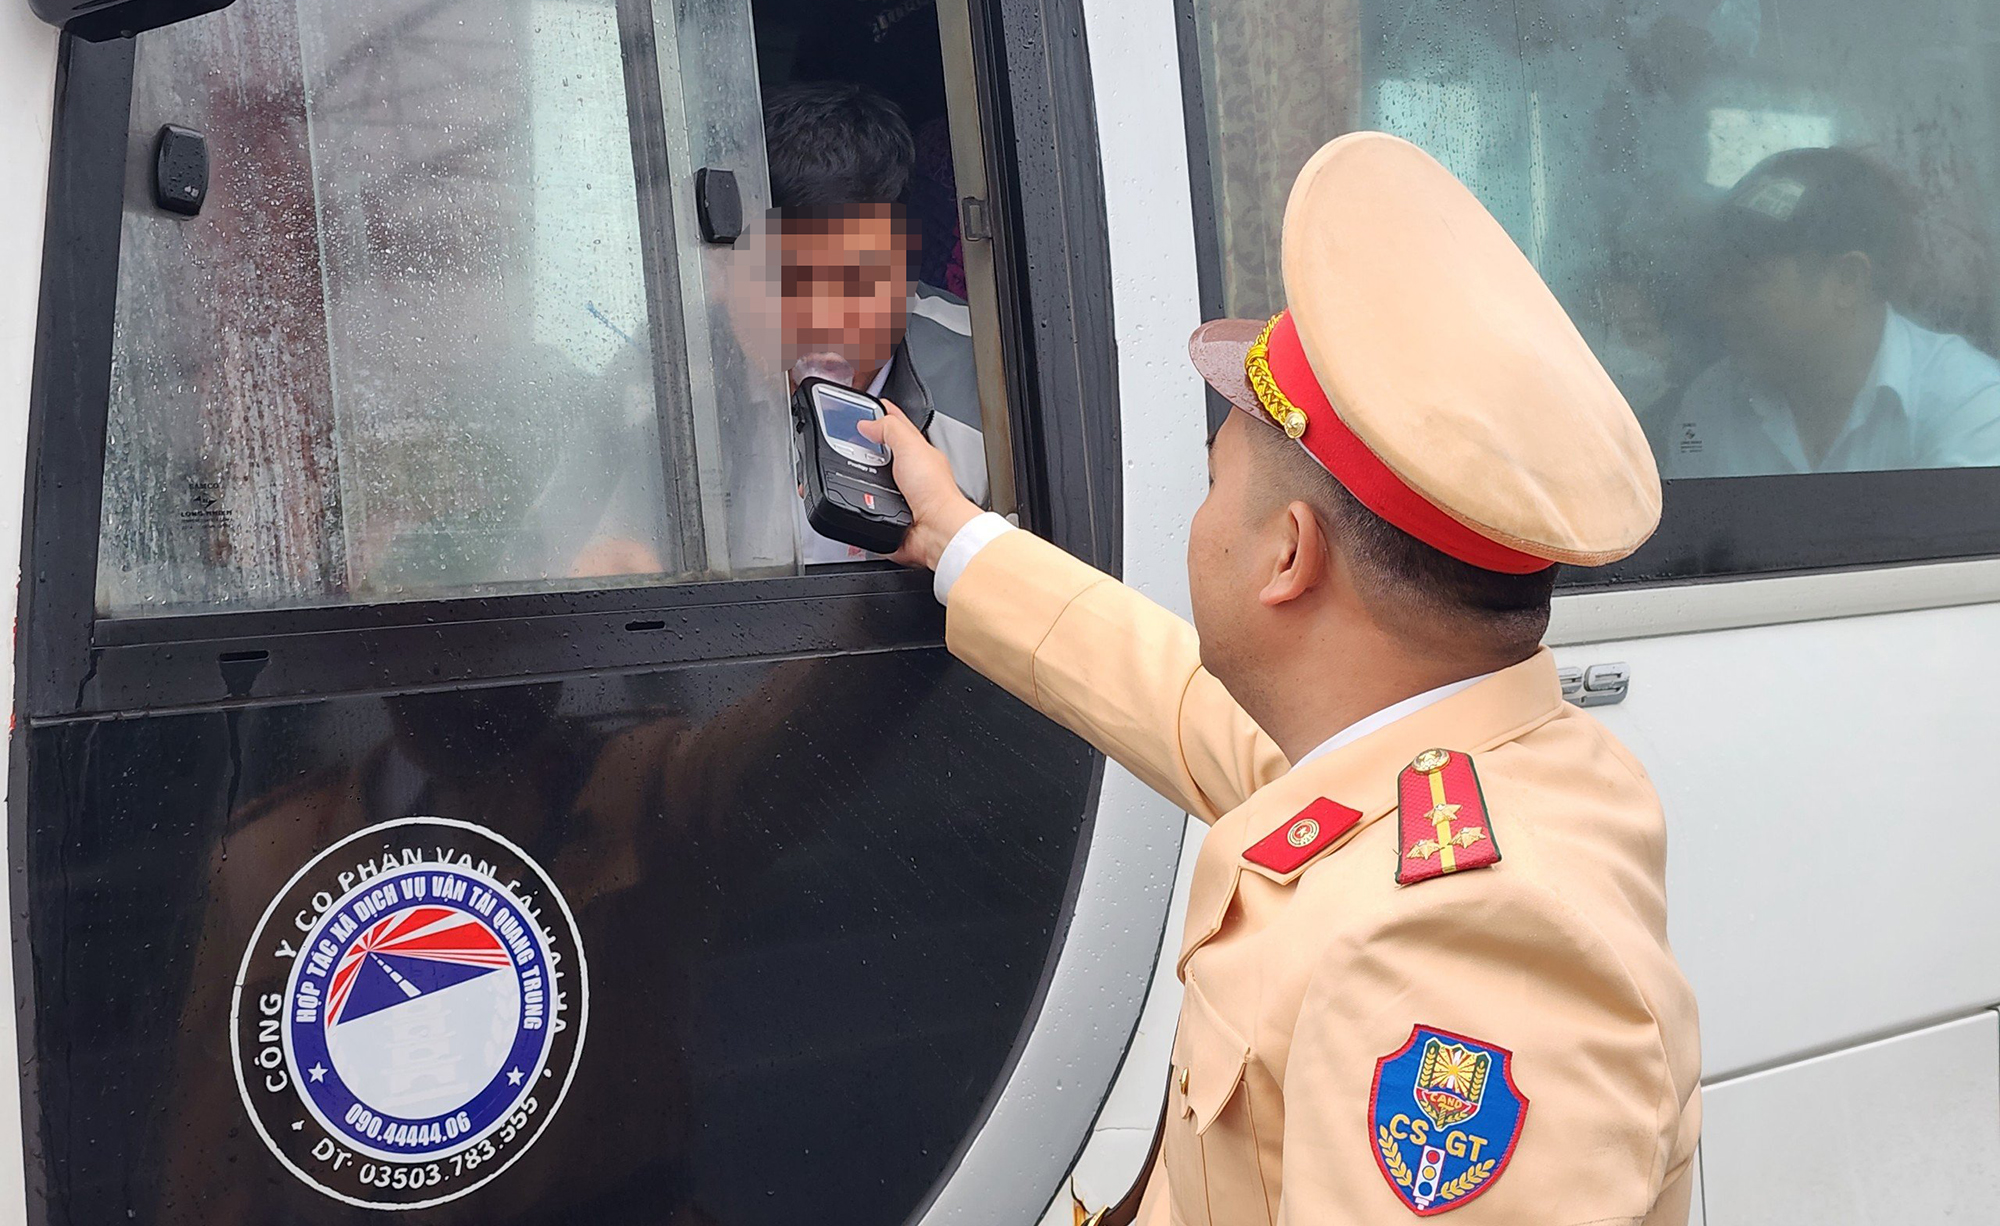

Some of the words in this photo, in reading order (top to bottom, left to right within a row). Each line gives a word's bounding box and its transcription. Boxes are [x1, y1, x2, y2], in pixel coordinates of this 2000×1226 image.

[353, 882, 399, 922] DỊCH
[400, 875, 426, 901] VỤ
[432, 874, 468, 903] VẬN
[468, 888, 498, 917] TẢI
[329, 911, 359, 944] XÃ
[493, 907, 535, 966] QUANG
[305, 939, 339, 978] TÁC
[295, 981, 322, 1023] HỢP
[521, 965, 544, 1030] TRUNG
[254, 992, 288, 1093] CÔNG
[345, 1103, 472, 1147] 090.44444.06
